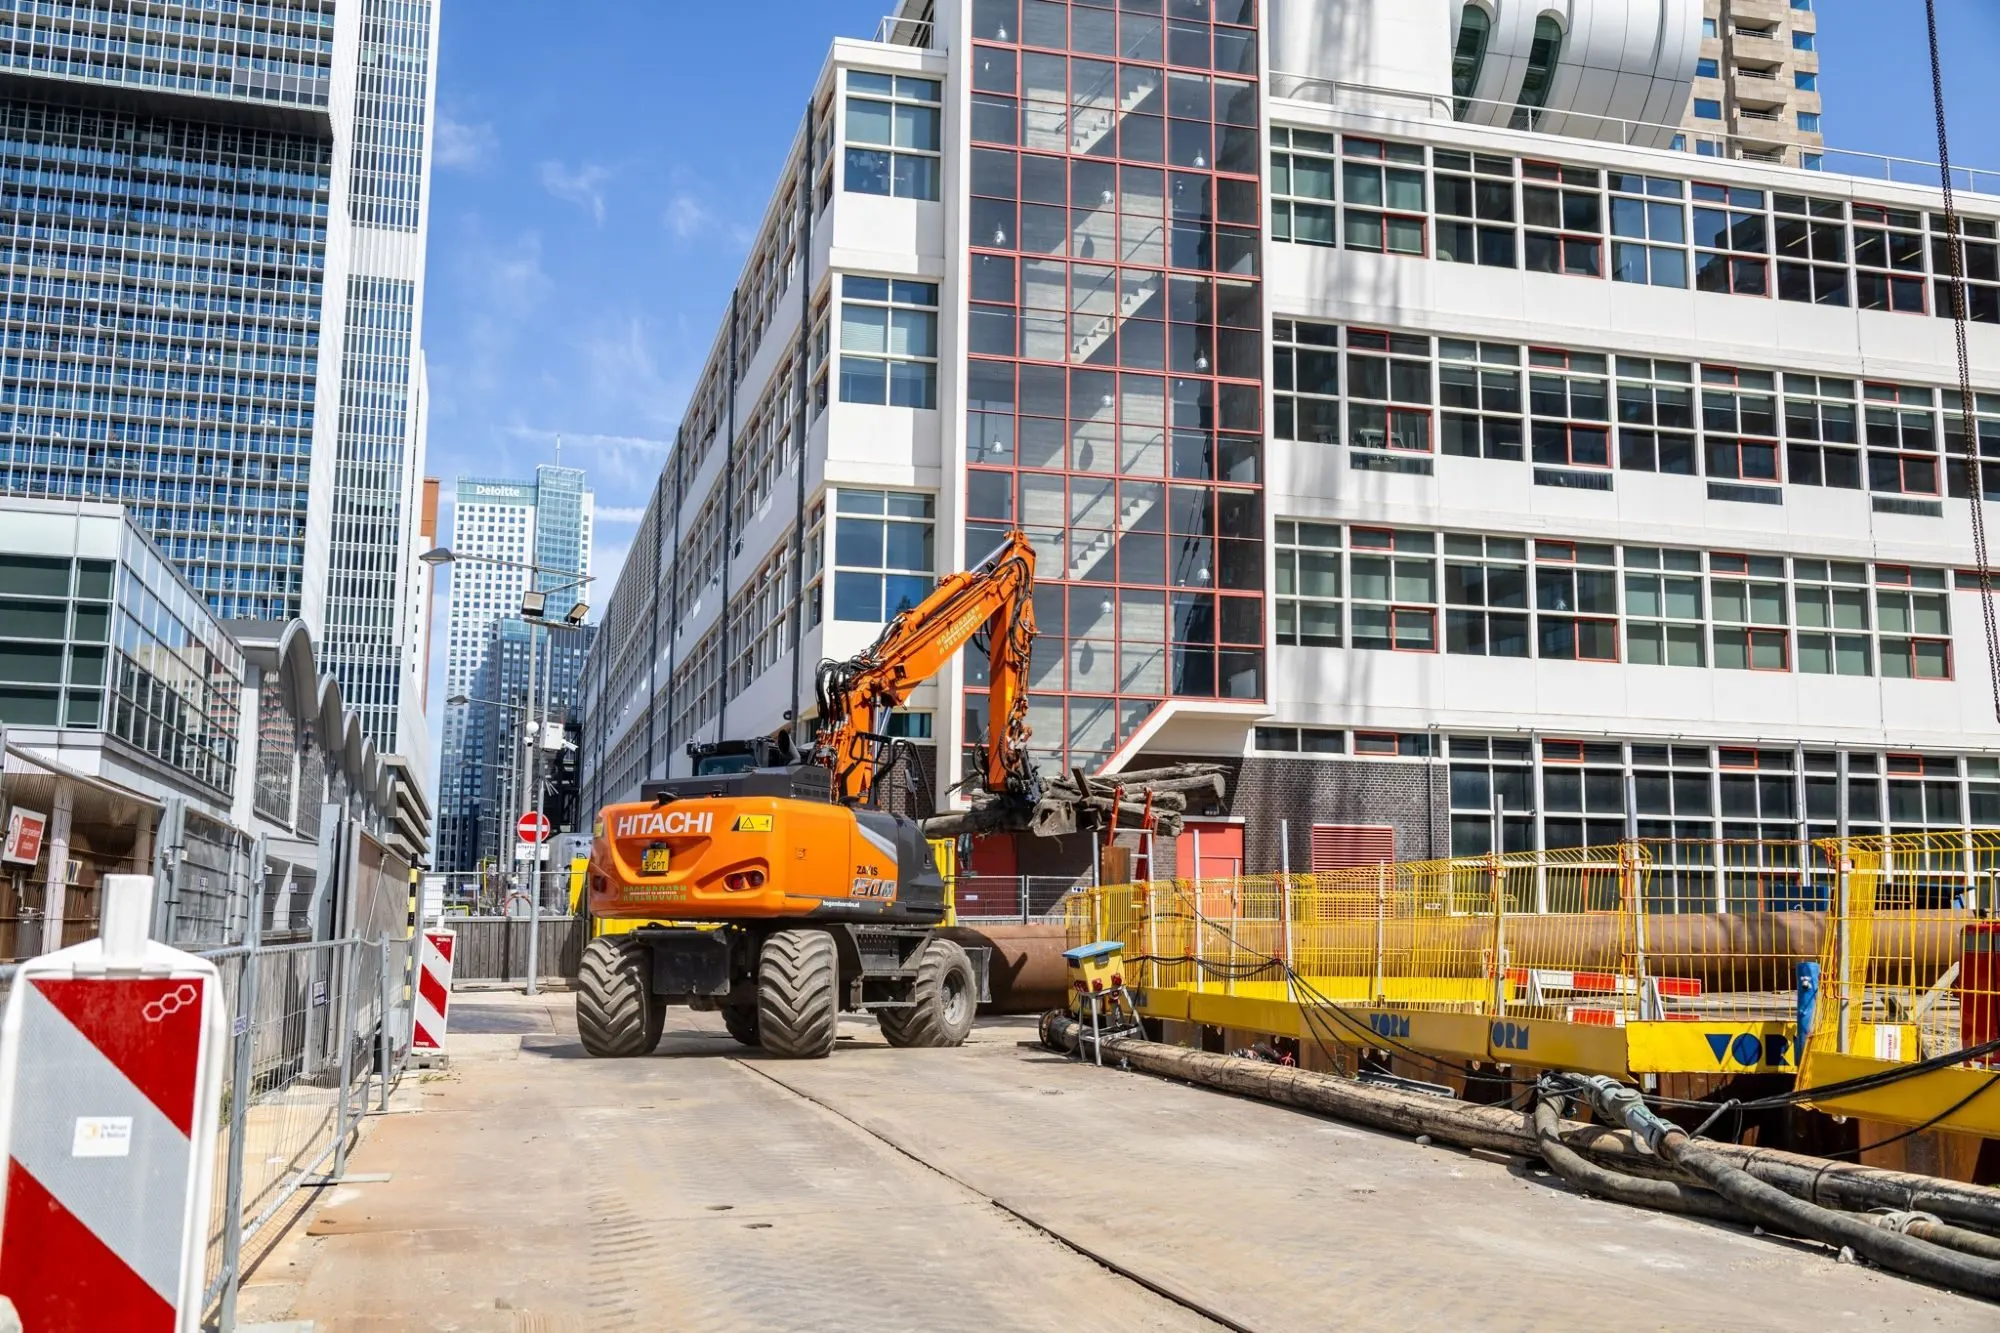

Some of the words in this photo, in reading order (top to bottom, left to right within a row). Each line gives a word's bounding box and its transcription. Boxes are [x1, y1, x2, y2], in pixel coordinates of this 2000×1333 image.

[476, 485, 520, 497] Deloitte
[617, 812, 713, 836] HITACHI
[1370, 1013, 1410, 1038] VORM
[1491, 1021, 1530, 1050] ORM
[1704, 1032, 1799, 1067] VOR
